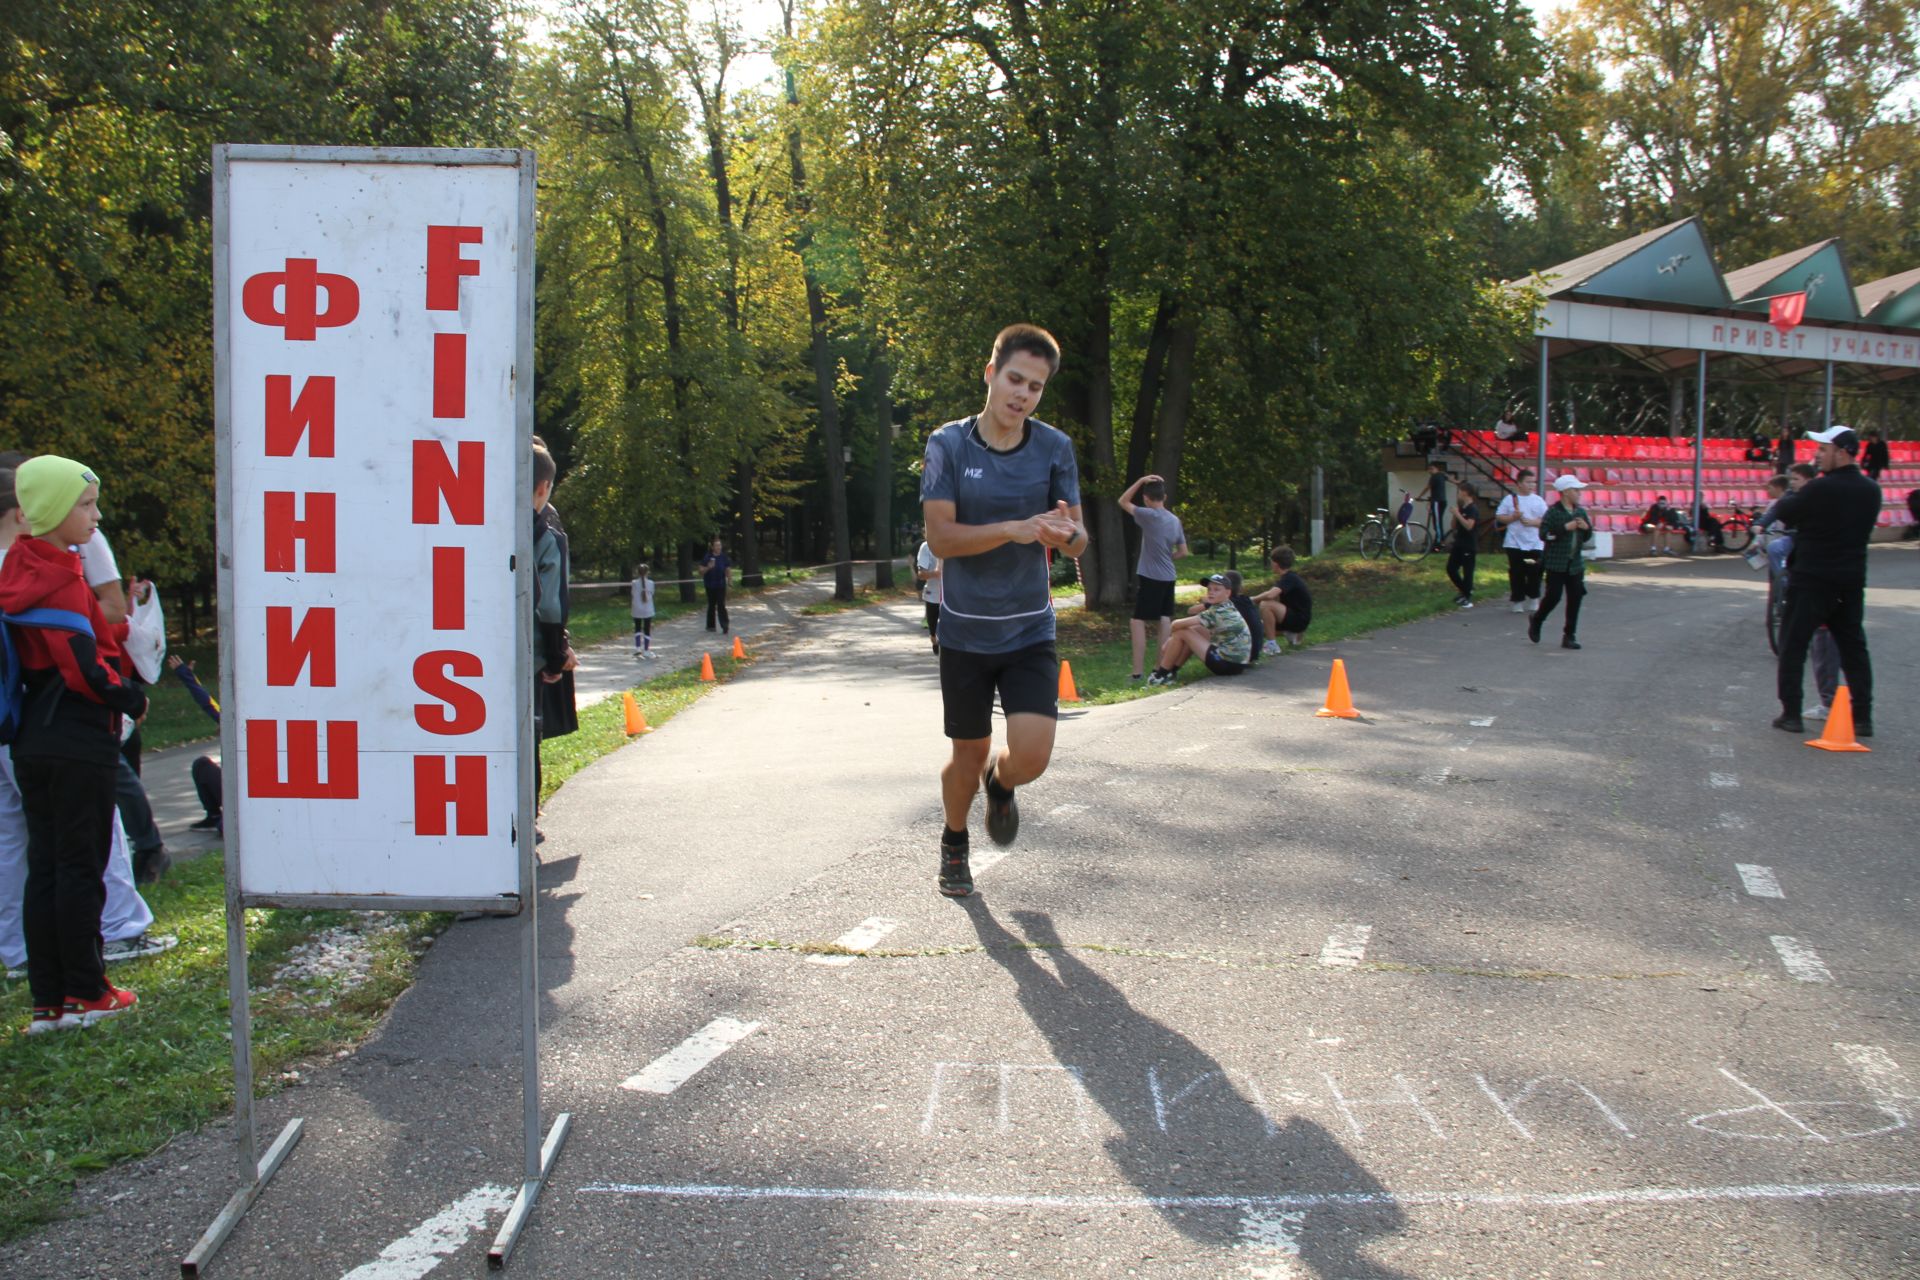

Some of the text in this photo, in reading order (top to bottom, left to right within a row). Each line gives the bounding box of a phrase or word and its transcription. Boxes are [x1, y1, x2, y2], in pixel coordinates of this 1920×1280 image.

[242, 258, 359, 799] ФИНИШ
[412, 225, 488, 836] FINISH
[1712, 325, 1806, 350] ПРИВЕТ
